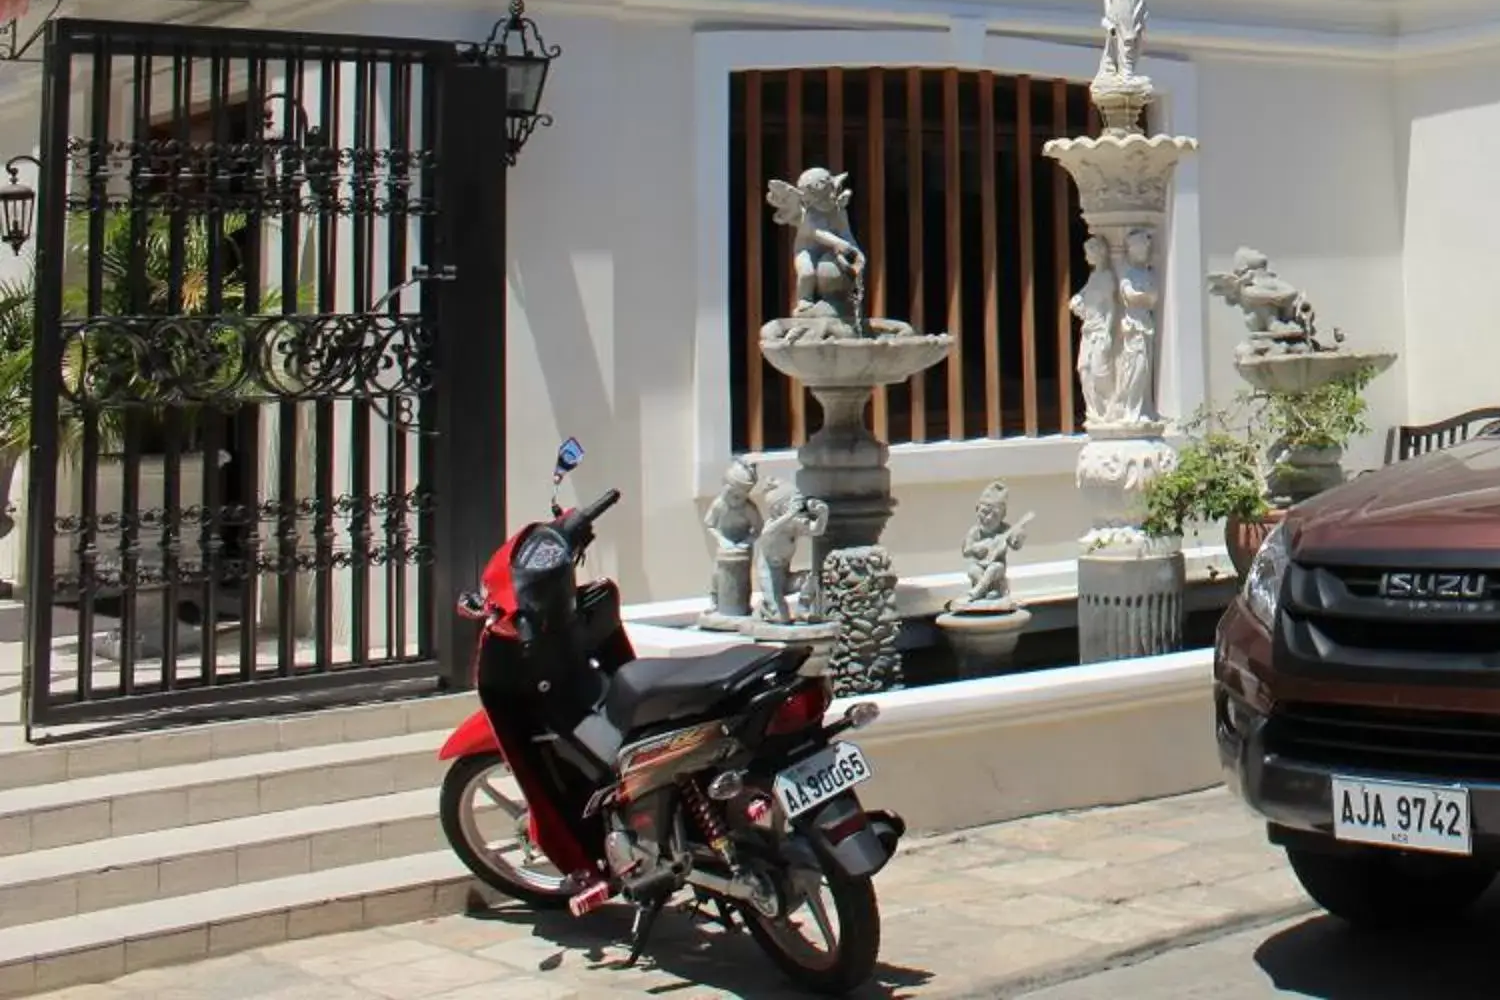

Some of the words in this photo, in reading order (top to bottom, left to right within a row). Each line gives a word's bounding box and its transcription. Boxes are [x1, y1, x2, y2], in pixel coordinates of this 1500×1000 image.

[1379, 573, 1485, 595] ISUZU
[784, 752, 864, 812] AA90065
[1342, 790, 1386, 828] AJA
[1397, 796, 1461, 836] 9742
